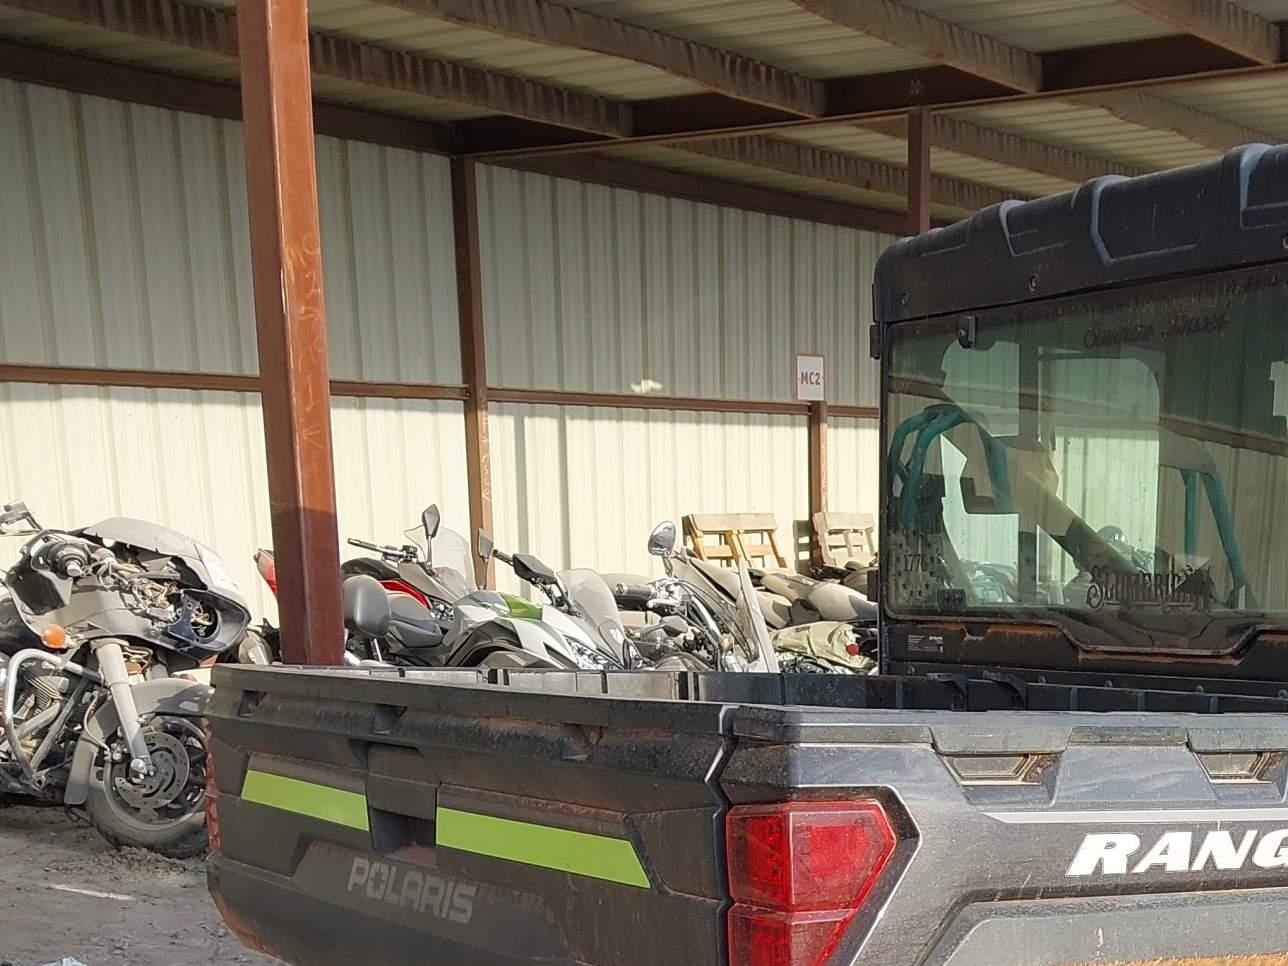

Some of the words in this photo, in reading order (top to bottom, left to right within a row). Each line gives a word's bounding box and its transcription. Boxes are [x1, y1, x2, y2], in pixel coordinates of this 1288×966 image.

[800, 371, 821, 385] MC2
[904, 553, 928, 572] 1776
[347, 856, 477, 924] POLARIS
